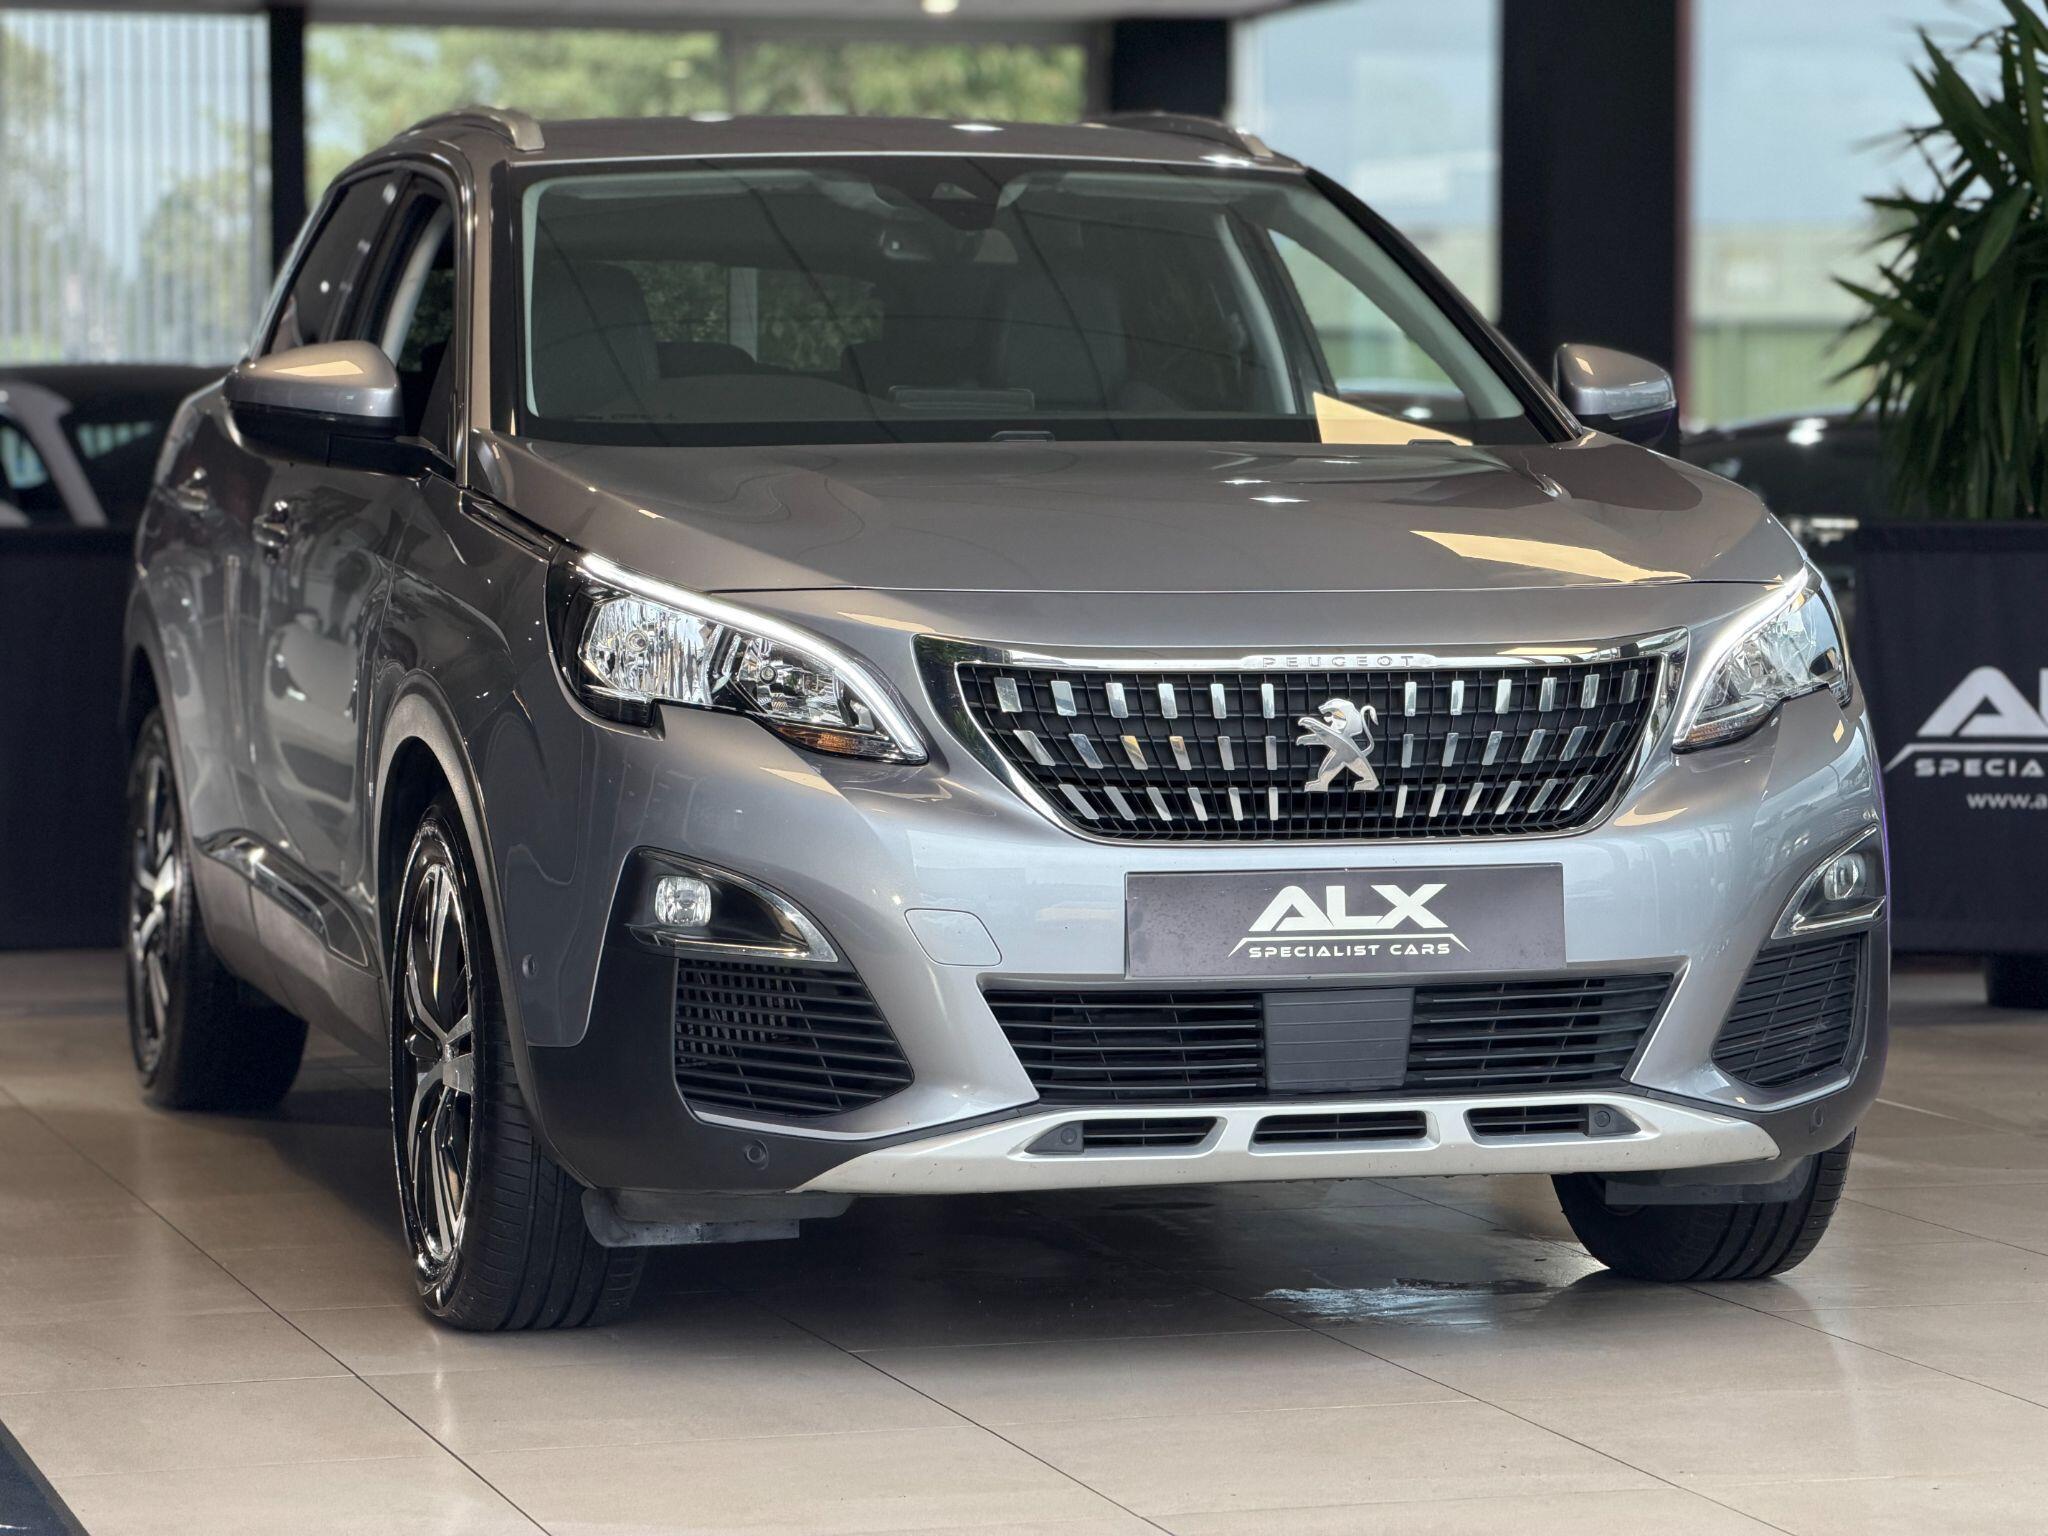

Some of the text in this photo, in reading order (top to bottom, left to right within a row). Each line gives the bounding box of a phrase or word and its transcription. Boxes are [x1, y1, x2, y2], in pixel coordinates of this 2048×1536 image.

[1262, 655, 1415, 668] PEUGEOT
[1916, 665, 2048, 737] A
[1914, 758, 2046, 777] SPECIA
[1248, 883, 1450, 932] ALX
[1248, 943, 1451, 959] SPECIALIST CARS
